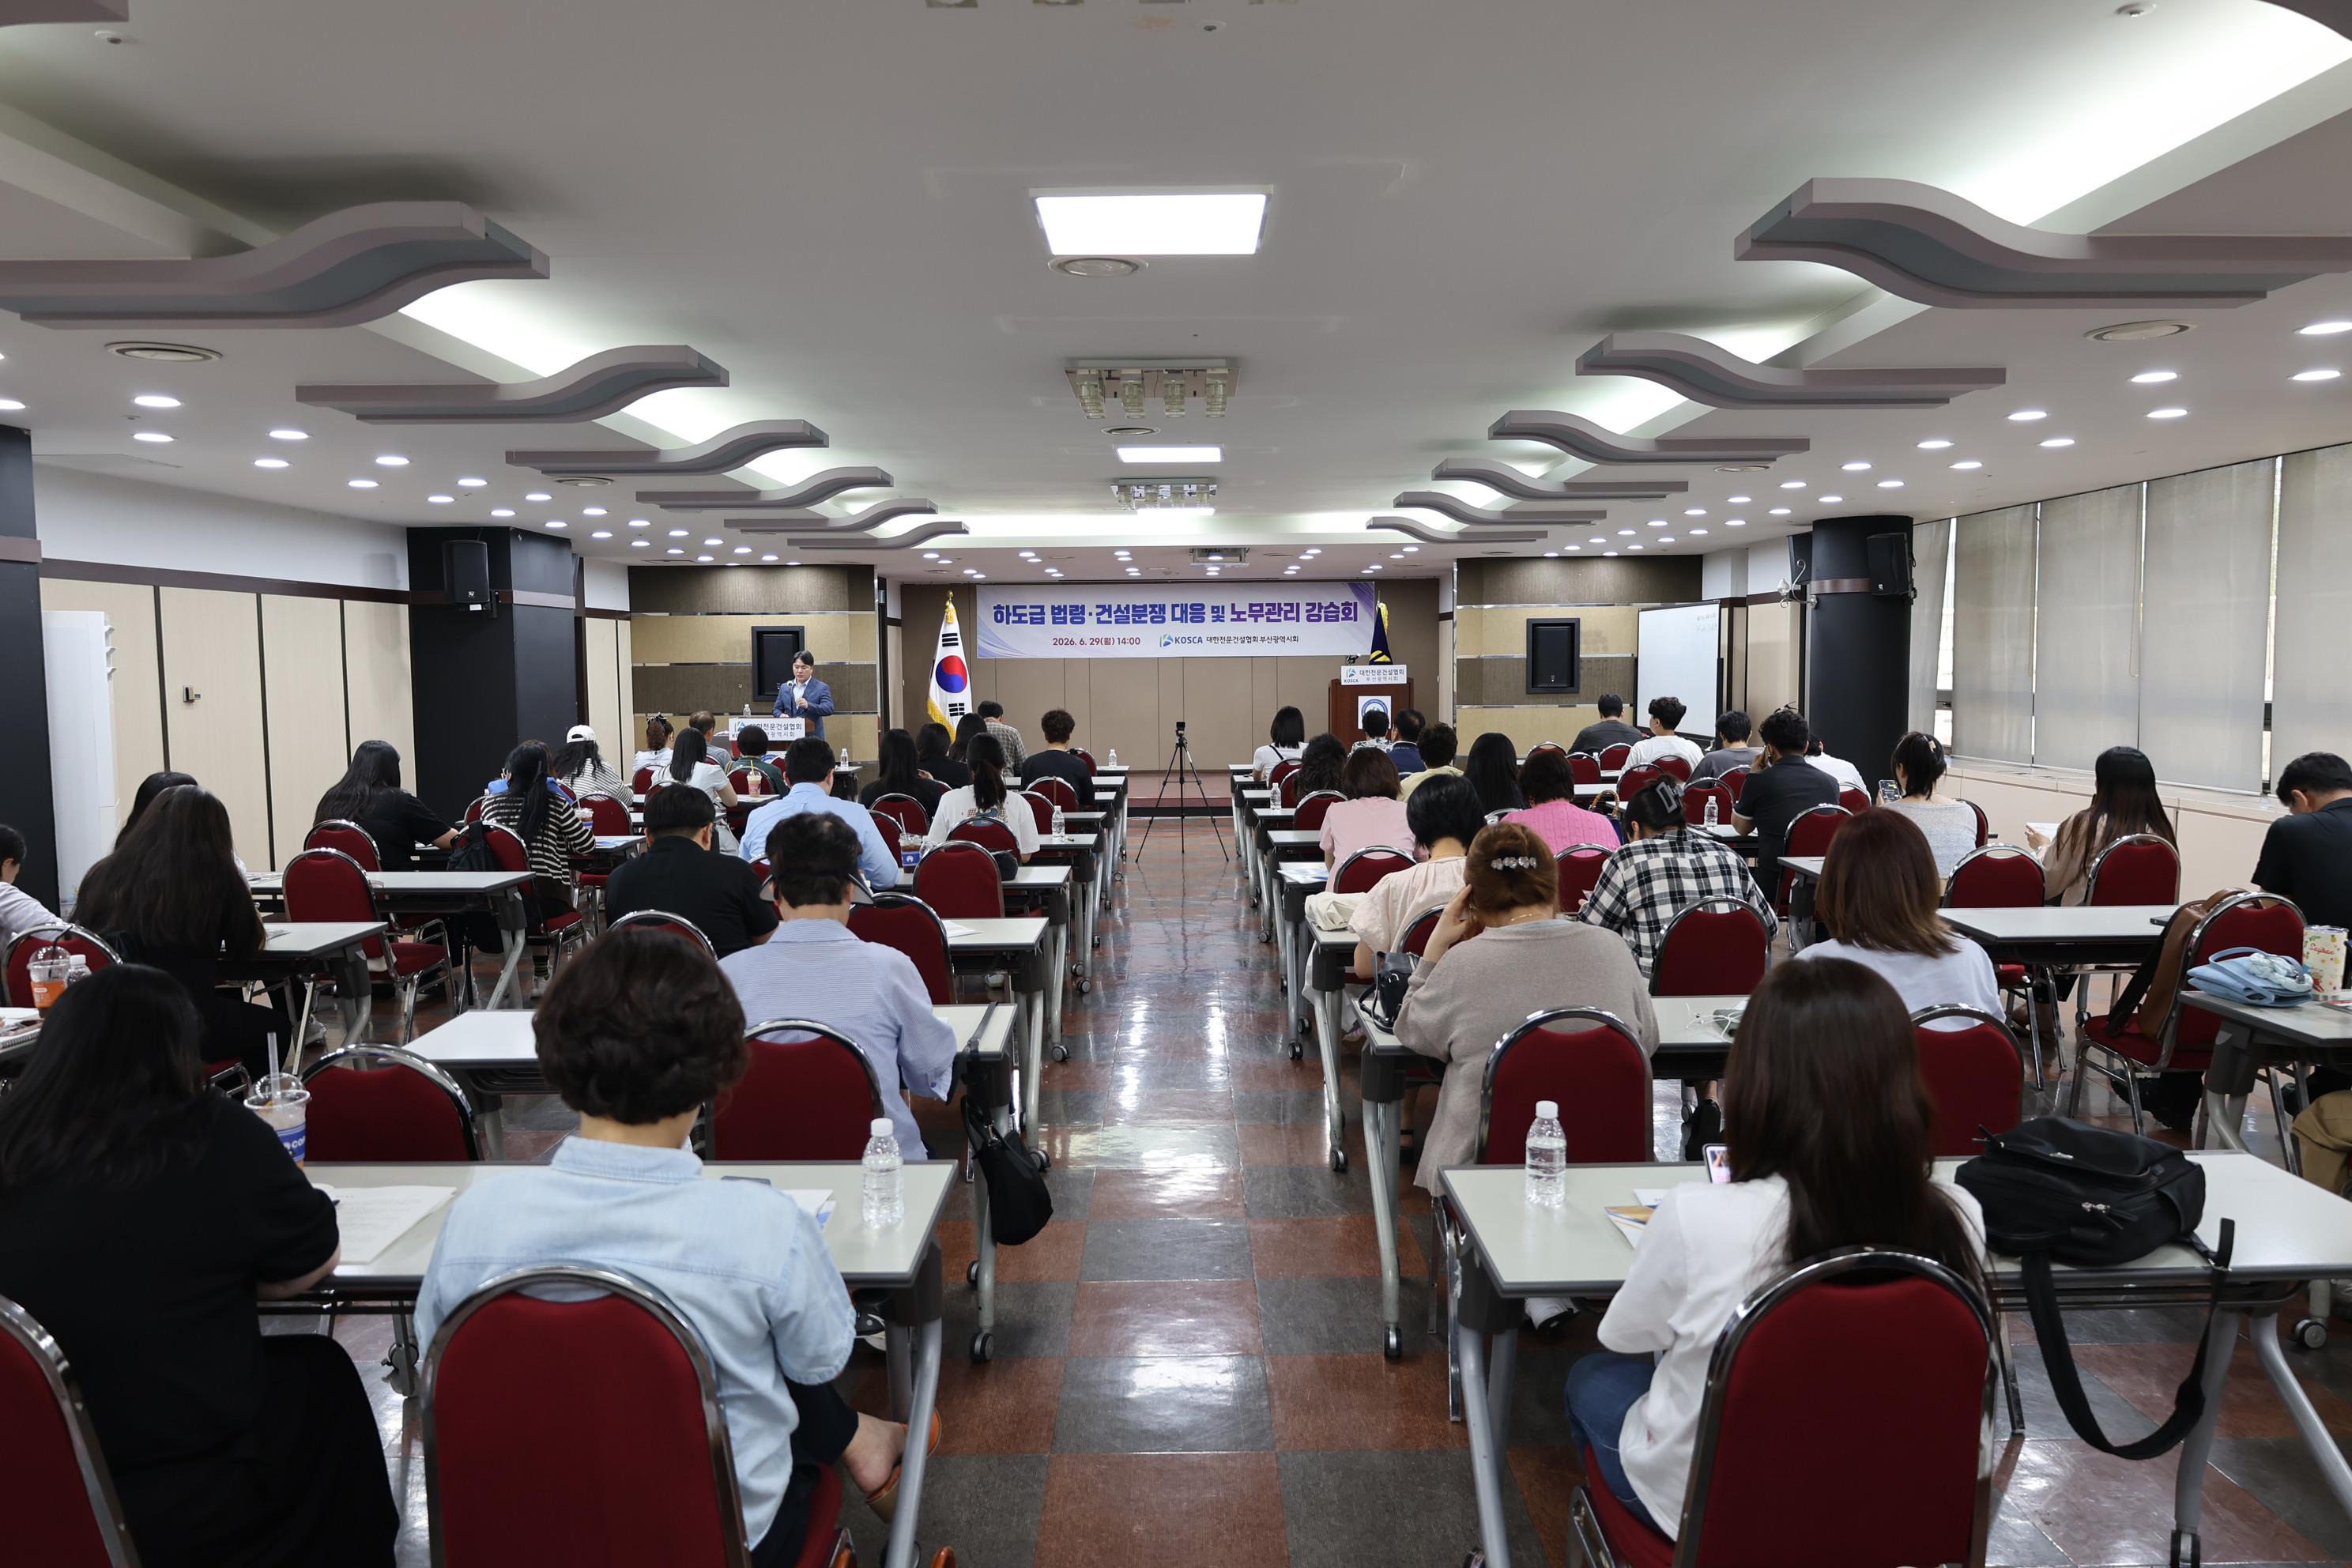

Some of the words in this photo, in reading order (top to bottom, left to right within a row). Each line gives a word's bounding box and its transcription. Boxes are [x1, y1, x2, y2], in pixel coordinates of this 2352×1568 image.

[993, 604, 1046, 625] 하도급
[1170, 602, 1206, 624] 대응
[1211, 605, 1225, 623] 및
[1230, 601, 1300, 623] 노무관리
[1305, 601, 1359, 623] 강습회
[1052, 637, 1077, 646] 2026.
[1079, 637, 1087, 646] 6.
[1089, 637, 1115, 646] 29(월)
[1117, 637, 1141, 646] 14:00
[1206, 635, 1258, 644] 대한전문건설협회
